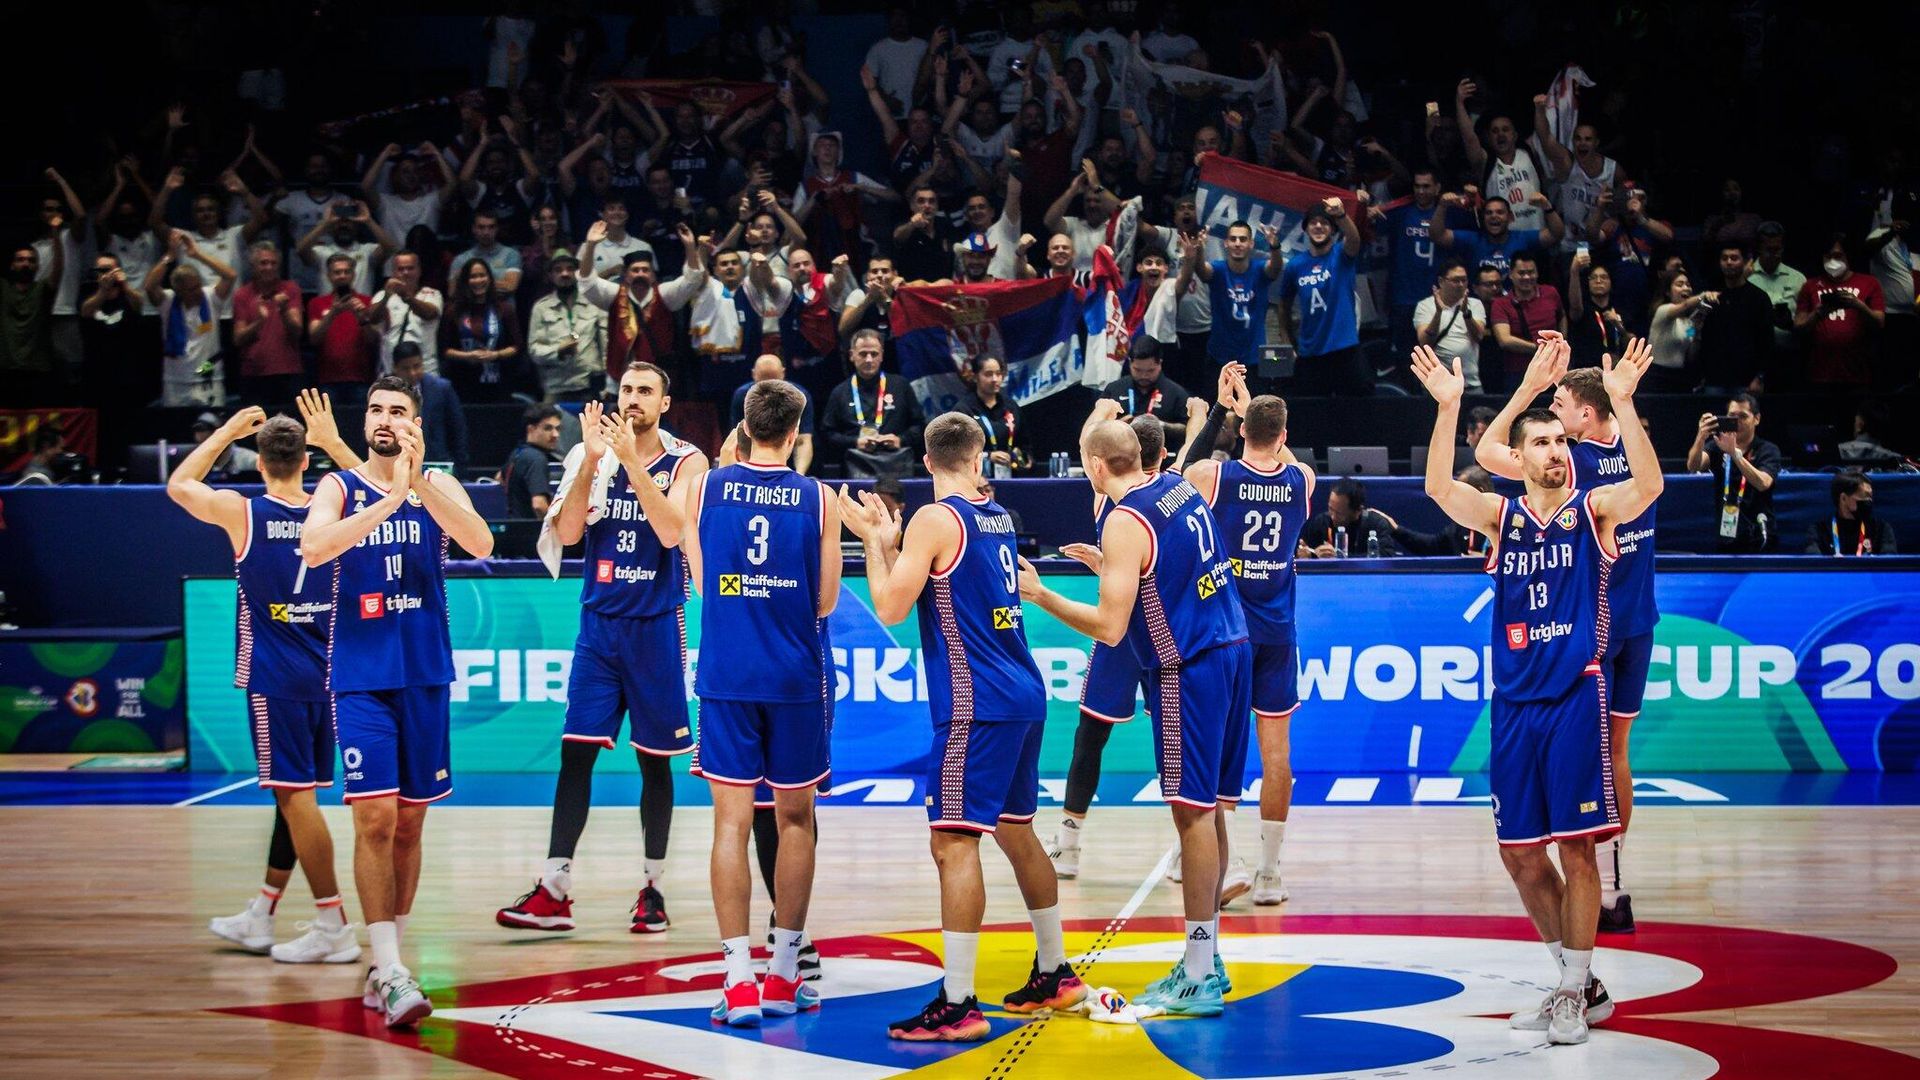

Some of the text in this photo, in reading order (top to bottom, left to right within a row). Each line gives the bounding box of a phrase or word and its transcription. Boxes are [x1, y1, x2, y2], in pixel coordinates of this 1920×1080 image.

[1238, 483, 1293, 503] GUDURIĆ
[615, 529, 637, 553] 33
[746, 514, 770, 566] 3
[1186, 504, 1215, 563] 27
[1241, 509, 1283, 553] 23
[1619, 543, 1638, 555] ank
[614, 565, 657, 584] triglav
[999, 544, 1017, 594] 9
[1243, 569, 1270, 581] Bank
[741, 574, 798, 589] Raiffeisen
[742, 586, 771, 599] Bank
[1527, 581, 1548, 611] 13
[1529, 620, 1573, 643] triglav
[450, 649, 571, 703] FIB
[1298, 644, 1493, 702] WOR
